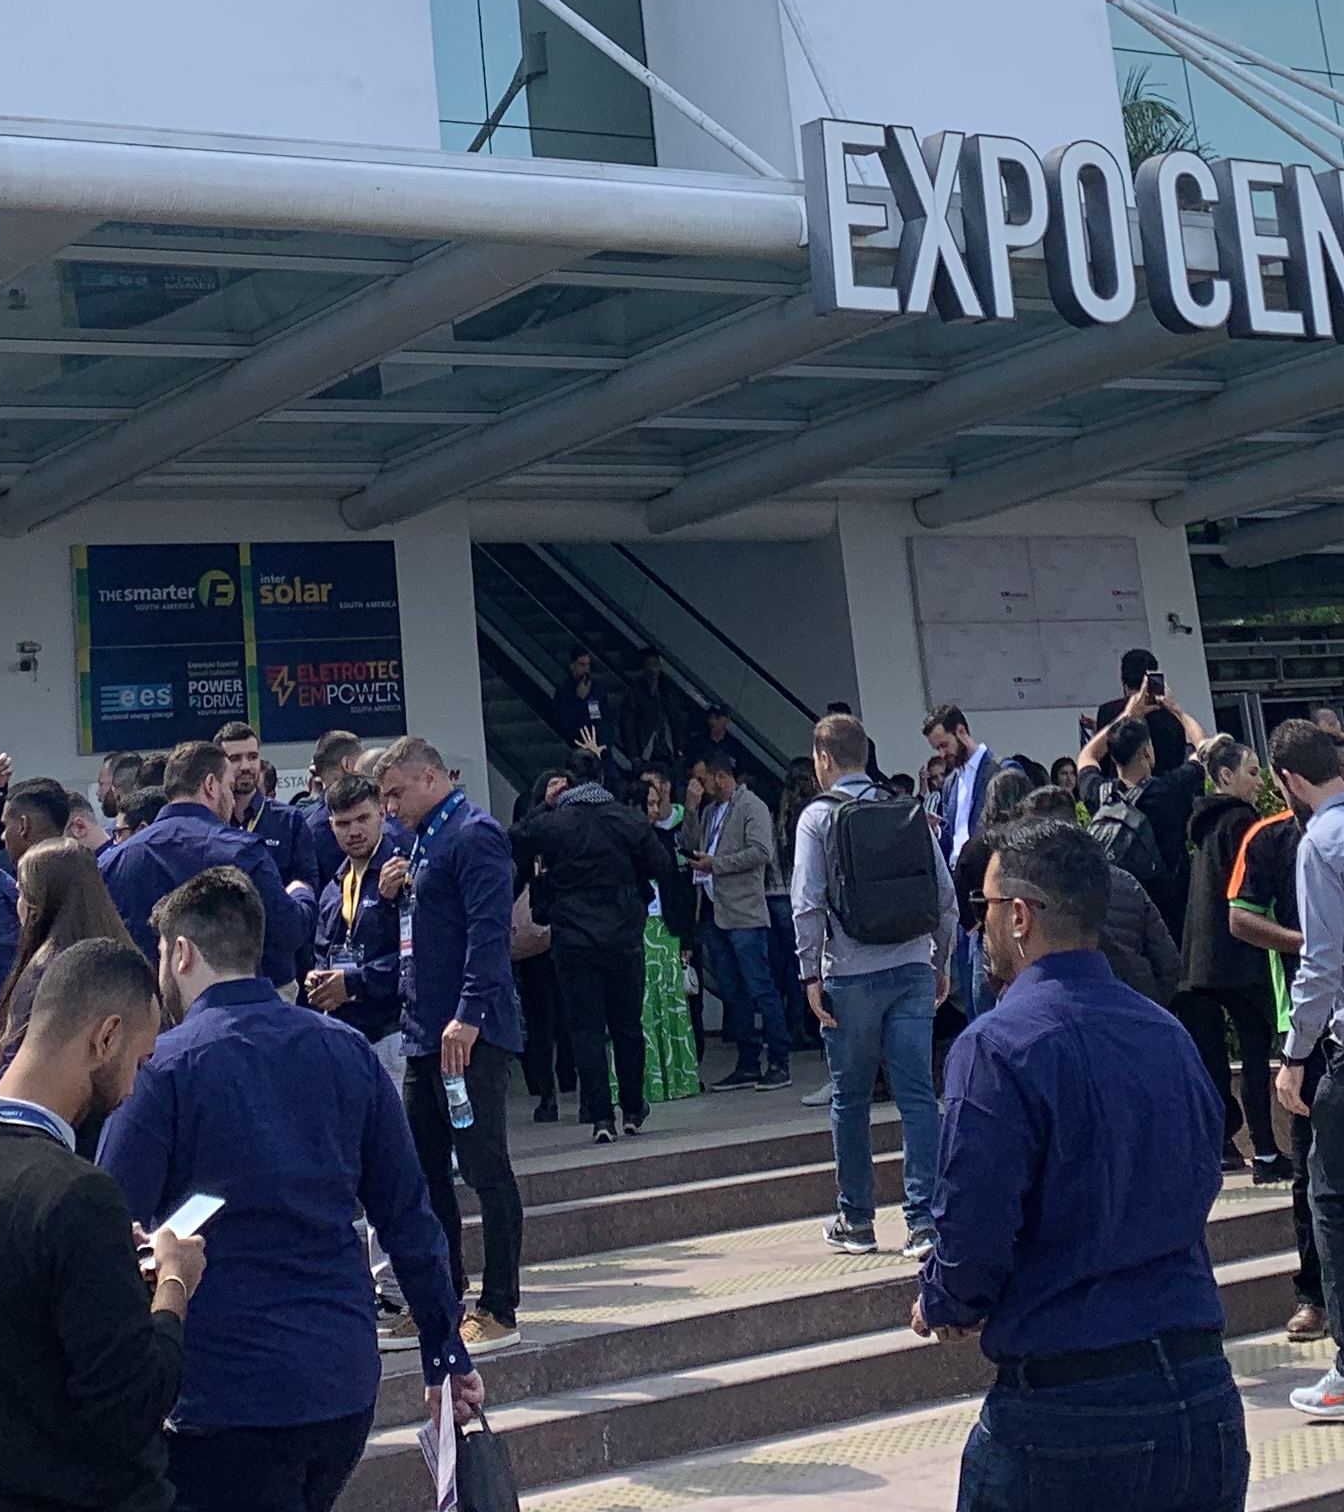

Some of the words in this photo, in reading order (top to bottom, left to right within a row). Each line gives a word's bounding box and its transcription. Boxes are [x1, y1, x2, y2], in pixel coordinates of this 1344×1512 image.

[801, 118, 1135, 328] EXPO
[259, 574, 286, 584] inter
[98, 590, 123, 602] THE
[124, 584, 196, 602] smarter
[259, 576, 333, 605] solar
[297, 660, 400, 683] ELETROTEC
[187, 679, 243, 694] POWER
[298, 682, 401, 707] EMPOWER
[119, 687, 172, 708] ees
[203, 693, 245, 709] DRIVE
[277, 775, 308, 789] ESTA
